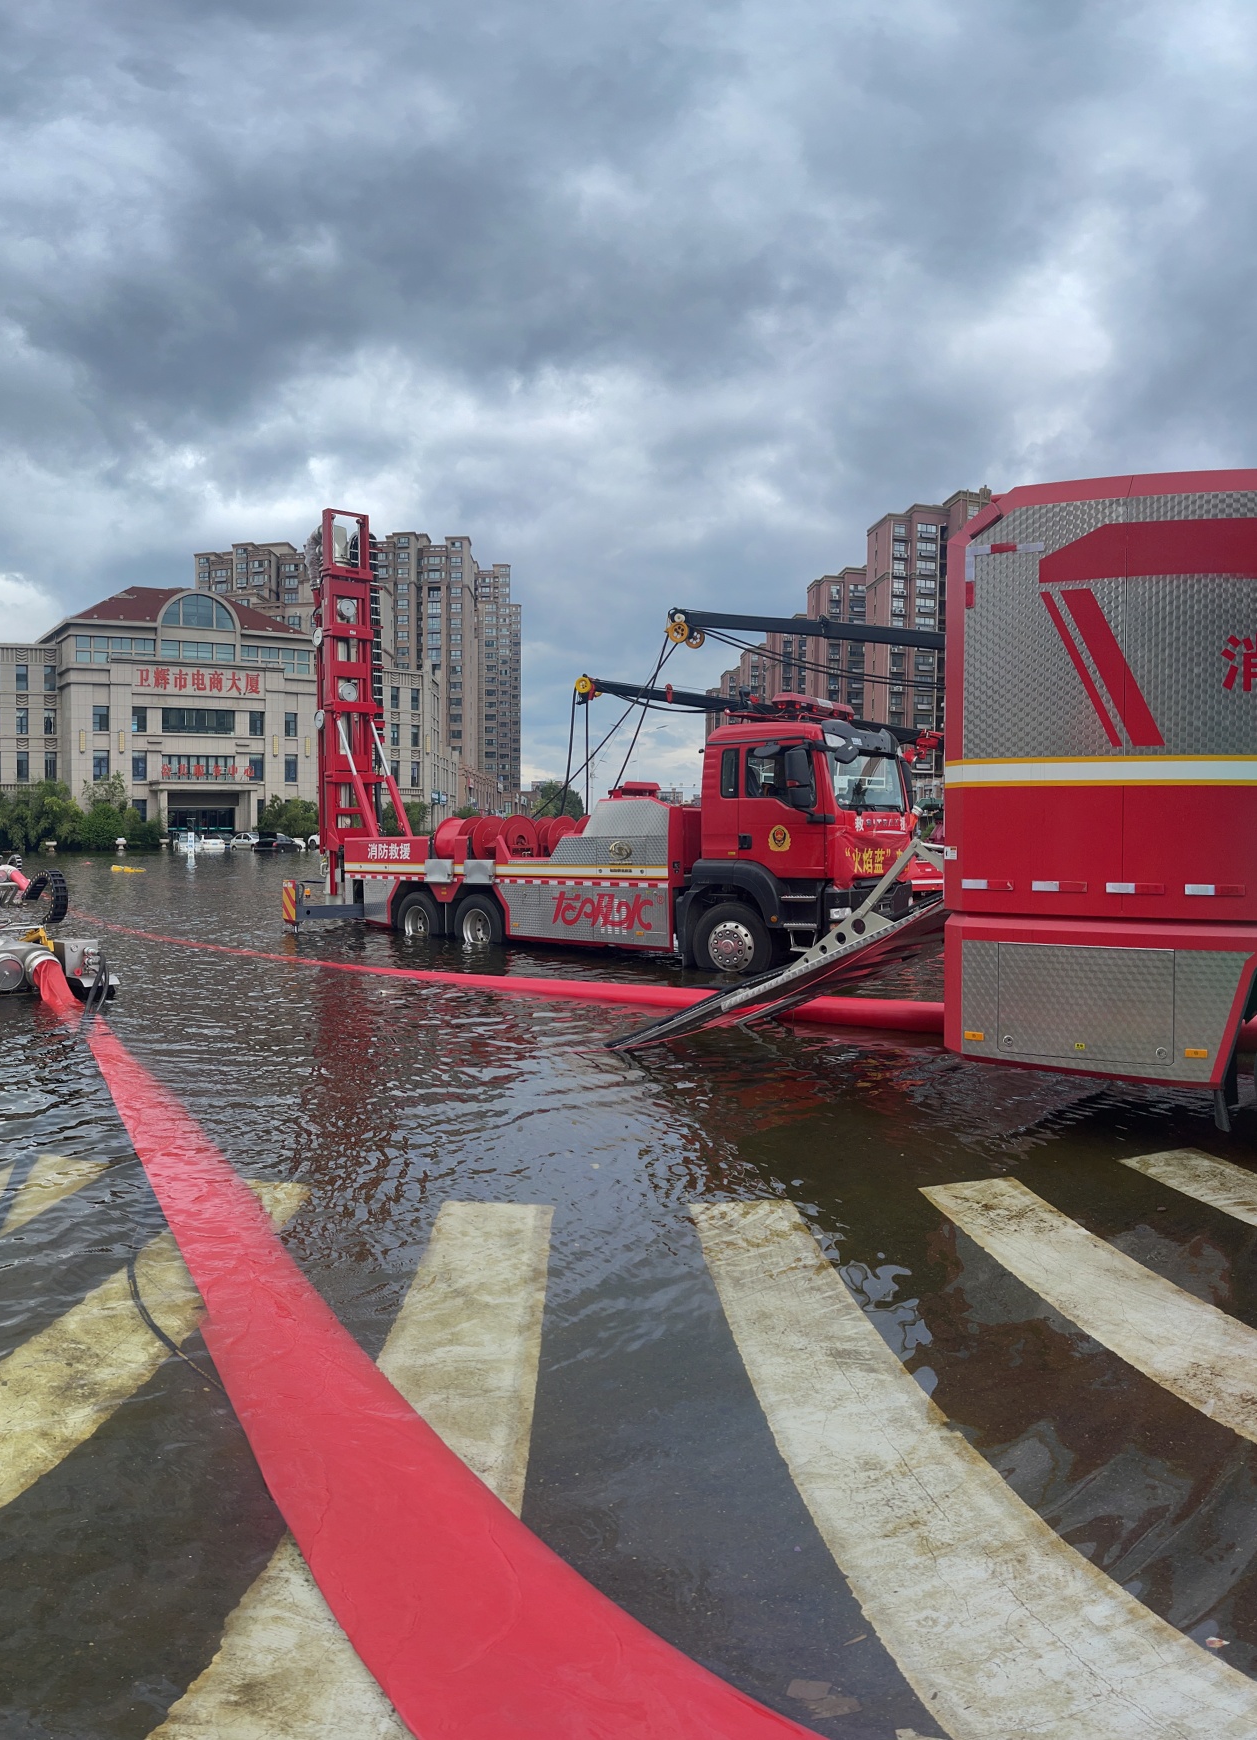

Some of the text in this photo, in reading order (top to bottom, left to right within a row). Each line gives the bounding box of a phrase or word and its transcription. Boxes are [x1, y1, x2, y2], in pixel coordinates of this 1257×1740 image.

[134, 667, 261, 695] 卫辉市电商大厦
[367, 843, 411, 860] 消防救援
